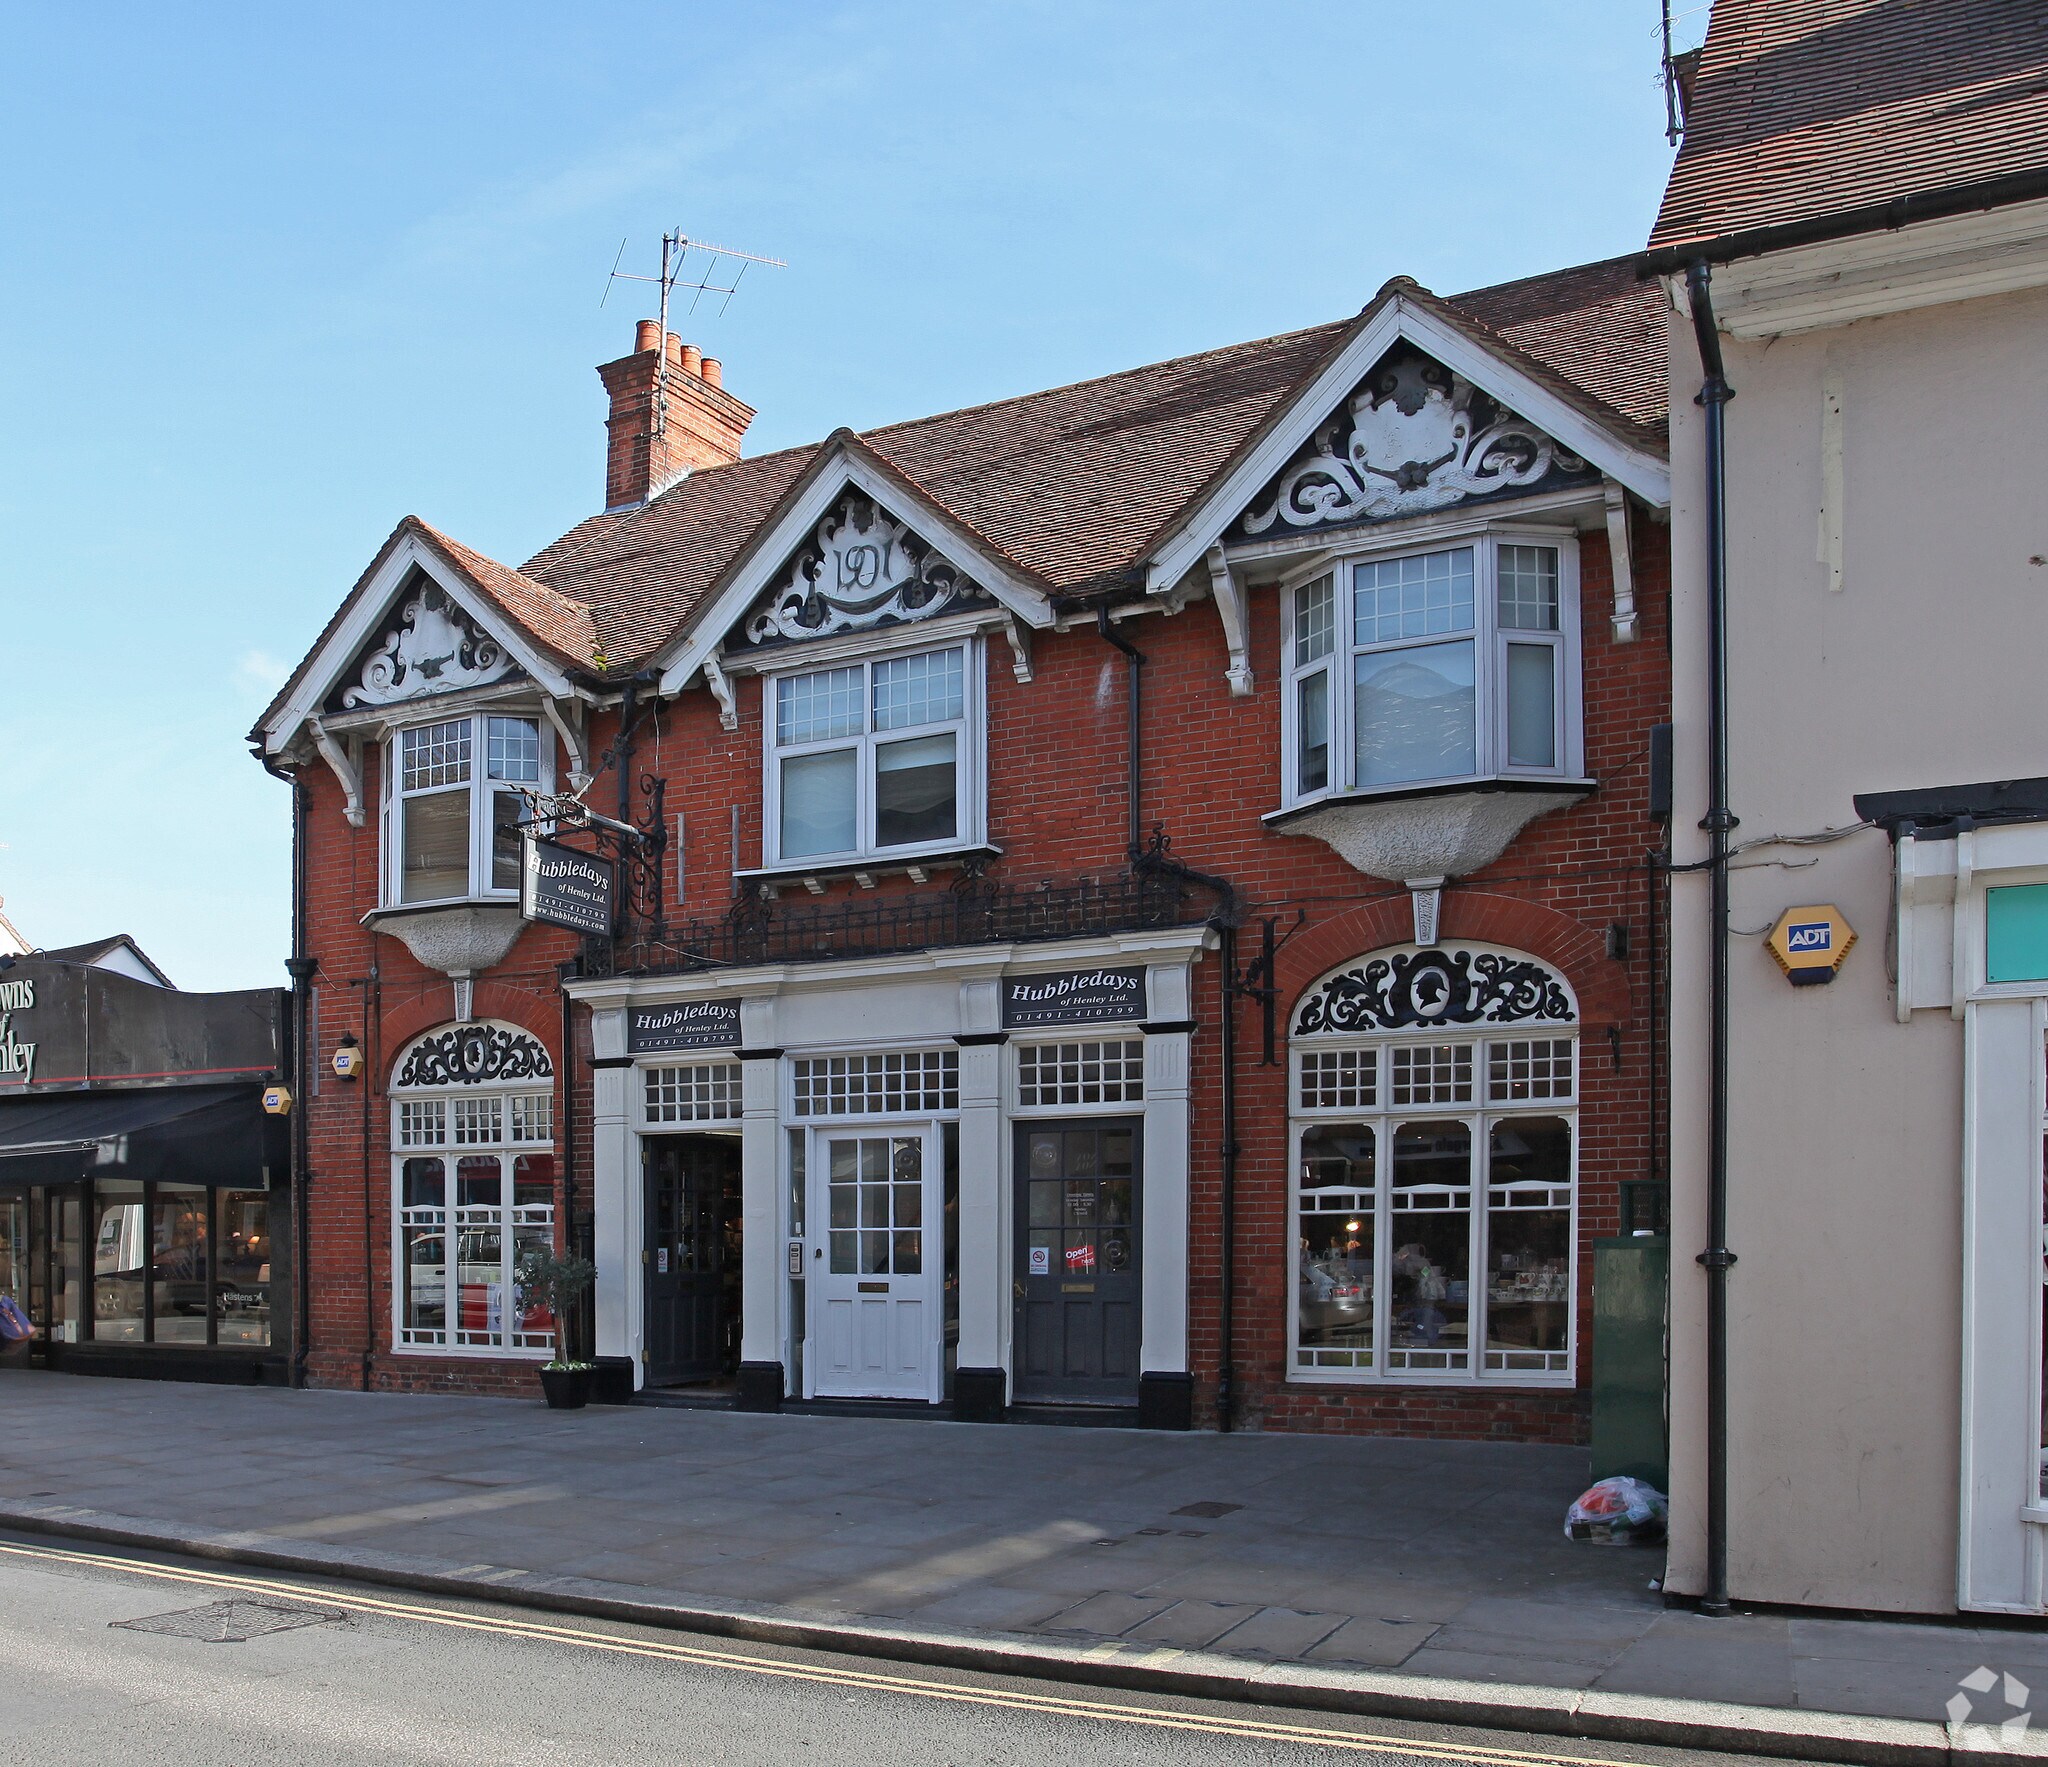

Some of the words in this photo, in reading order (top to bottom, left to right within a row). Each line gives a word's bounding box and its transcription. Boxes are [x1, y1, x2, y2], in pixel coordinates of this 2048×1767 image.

[833, 539, 893, 592] 1901
[528, 852, 609, 890] Hubbledays
[558, 884, 567, 894] of
[567, 885, 591, 901] Henley
[592, 893, 606, 904] Ltd.
[531, 905, 605, 931] www.hubbledays.com
[1788, 928, 1830, 947] ADT
[0, 980, 34, 1010] wns
[1011, 970, 1138, 1001] Hubbledays
[1060, 998, 1071, 1006] of
[1073, 996, 1106, 1005] Henley
[1109, 994, 1128, 1002] Ltd.
[636, 1002, 737, 1029] Hubbledays
[675, 1026, 684, 1034] of
[0, 1030, 36, 1084] nley
[337, 1058, 350, 1067] ADT
[1065, 1247, 1088, 1260] Open
